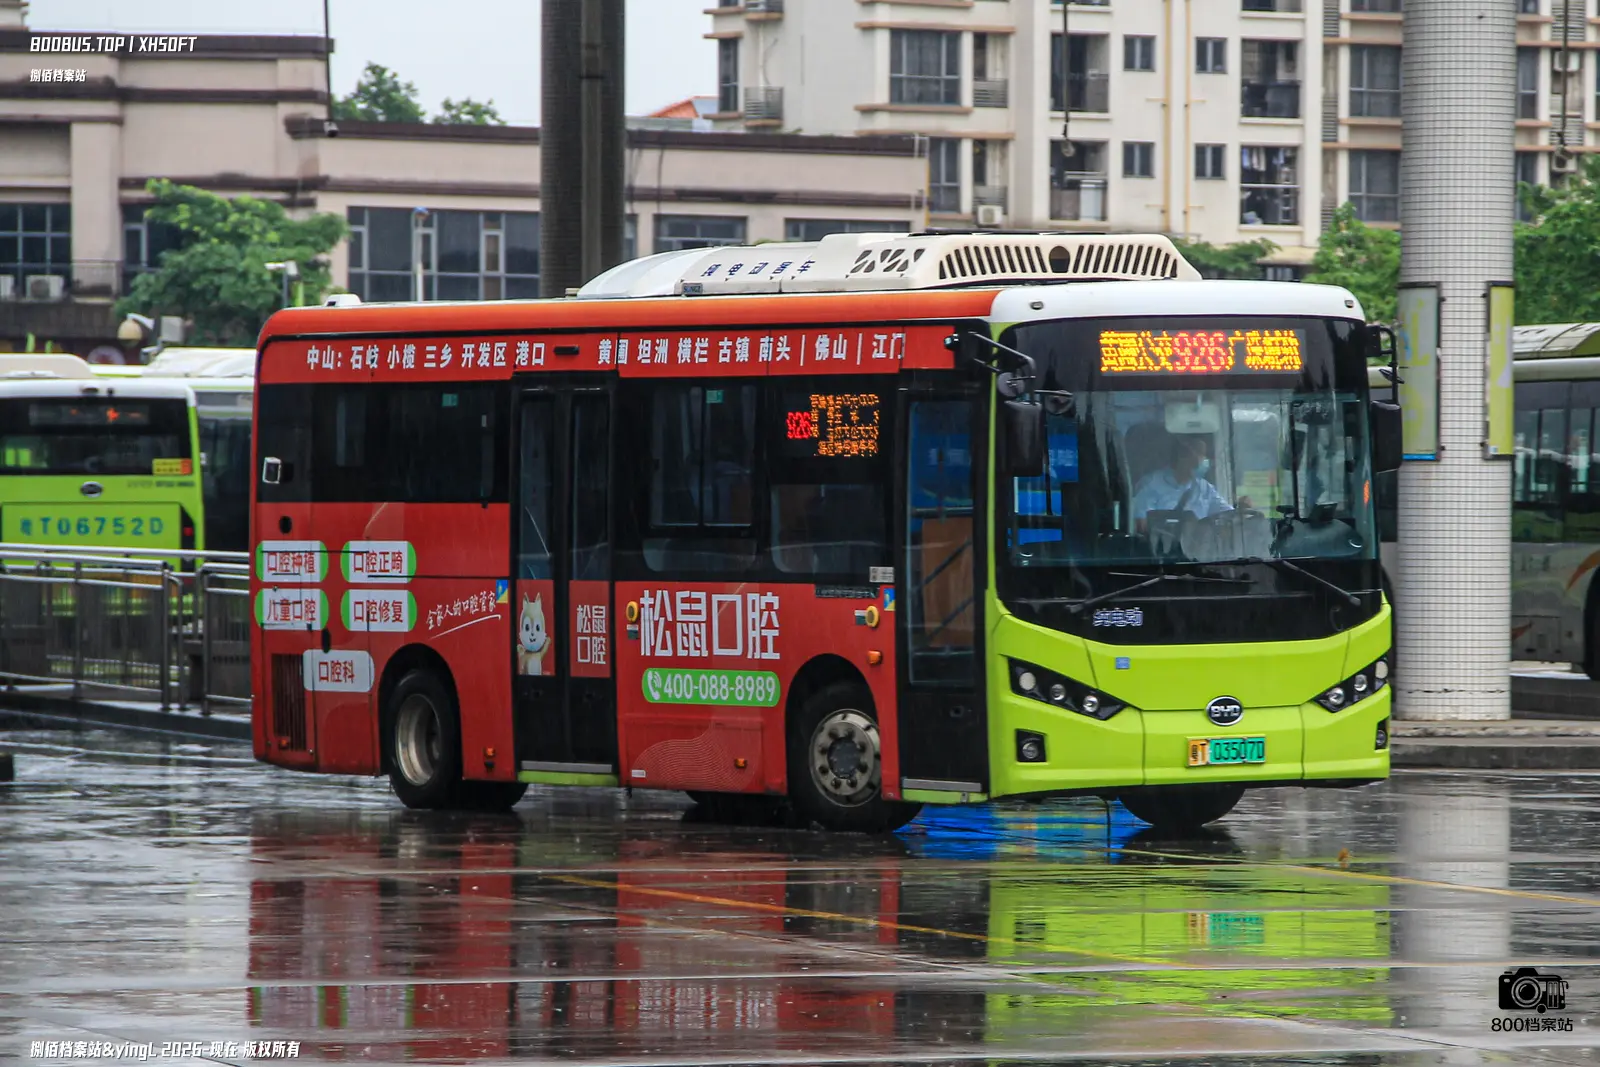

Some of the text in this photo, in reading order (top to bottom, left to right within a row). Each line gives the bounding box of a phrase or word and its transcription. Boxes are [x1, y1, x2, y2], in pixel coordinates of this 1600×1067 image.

[350, 345, 380, 369] 石岐
[387, 344, 416, 369] 小榄
[423, 343, 453, 369] 三乡
[461, 342, 508, 368] 开发区
[515, 341, 546, 366] 港口
[597, 337, 629, 365] 黄圃
[637, 338, 668, 364] 坦洲
[677, 337, 709, 364] 横栏
[718, 336, 750, 363] 古镇
[758, 335, 790, 362] 南头
[815, 334, 847, 361] 佛山
[872, 333, 906, 360] 江门
[267, 551, 316, 574] 口腔种植
[354, 550, 403, 573] 口腔正畸
[267, 599, 316, 621] 儿童口腔
[354, 600, 403, 622] 口腔修复
[576, 605, 606, 633] 松鼠
[1093, 607, 1143, 627] 纯电动
[640, 590, 780, 659] 松鼠口腔
[577, 636, 606, 664] 口腔
[318, 661, 355, 683] 口腔科
[663, 675, 776, 701] 400-088-8989
[1210, 705, 1240, 717] BYD
